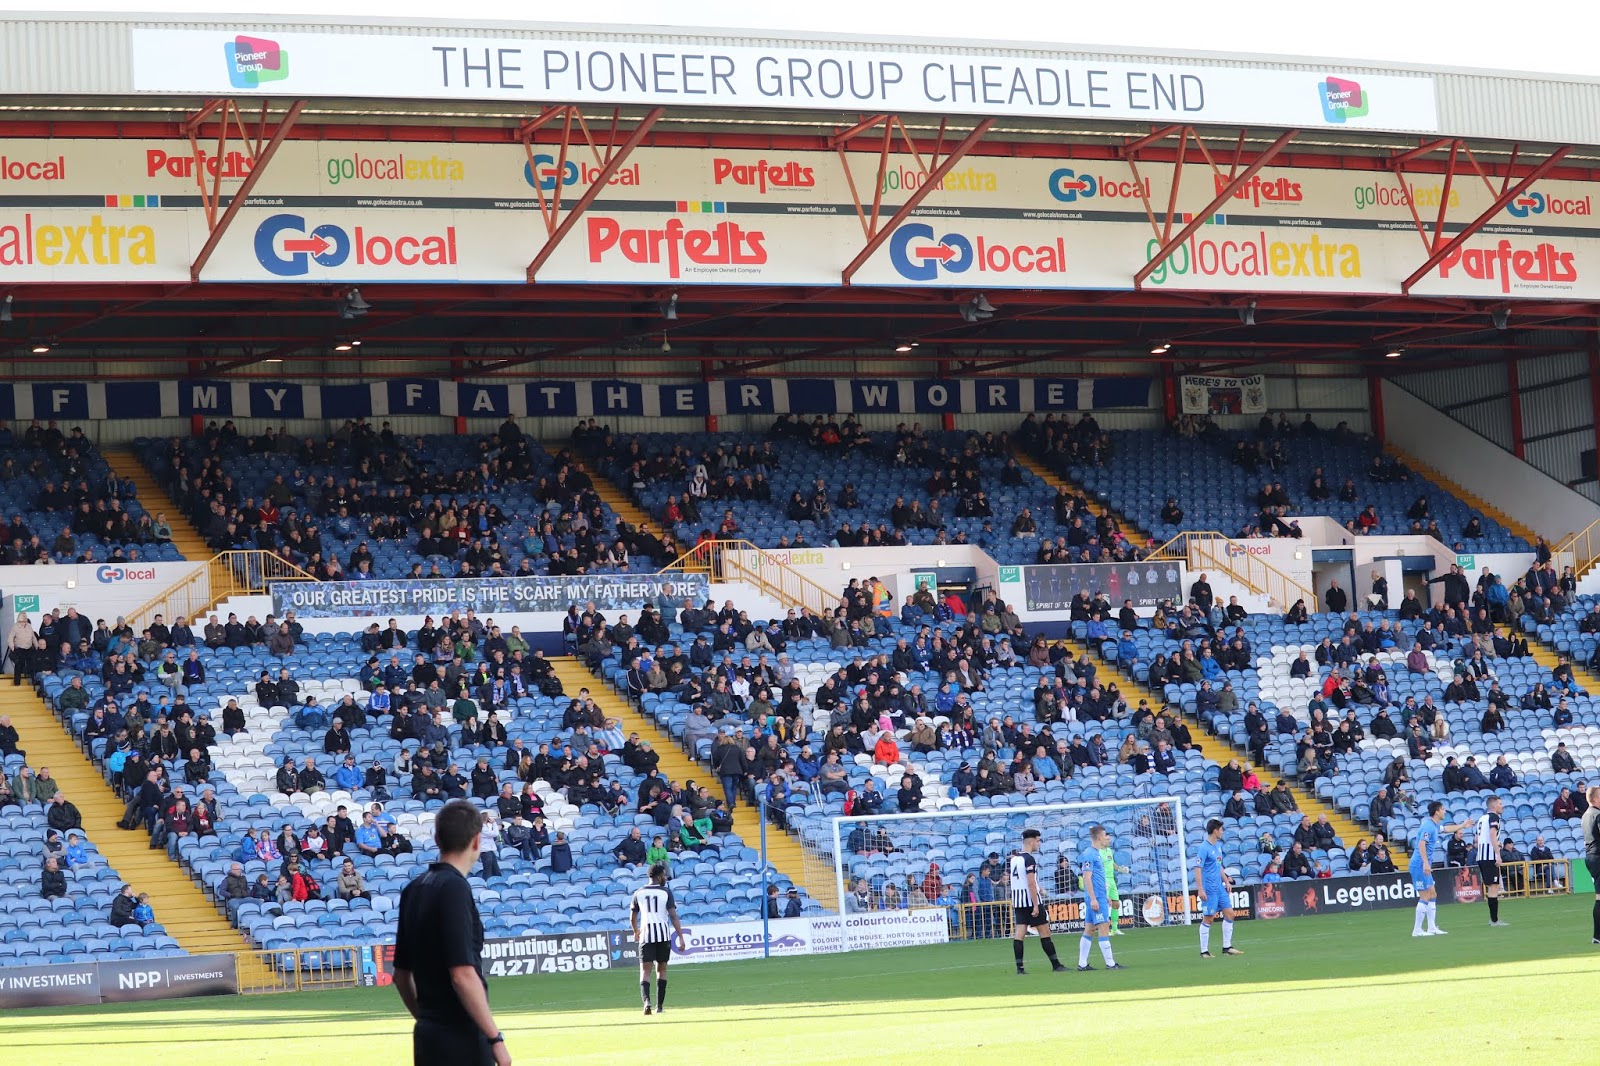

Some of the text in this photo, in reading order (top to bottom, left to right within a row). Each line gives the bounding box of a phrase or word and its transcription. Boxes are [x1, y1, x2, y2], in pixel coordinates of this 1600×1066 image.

[234, 51, 267, 63] Pioneer
[236, 63, 263, 73] Group
[432, 46, 1205, 113] THE PIONEER GROUP CHEADLE END
[1327, 91, 1352, 101] Pioneer
[1328, 101, 1348, 110] Group
[1, 156, 65, 180] local
[327, 153, 464, 184] golocalextra
[714, 158, 815, 194] Parfetts
[1048, 168, 1151, 202] Go local
[1355, 181, 1459, 209] golocalexta
[357, 198, 423, 207] www.golocalextra.co.uk
[787, 206, 837, 214] www.parfetts.co.uk
[1546, 194, 1591, 215] local
[254, 213, 457, 277] Go local
[587, 217, 767, 279] Parfetts
[889, 222, 1066, 281] Go local
[1146, 231, 1361, 285] golocalextra
[1437, 237, 1577, 293] Parfetts
[1185, 377, 1220, 387] HERE'S
[1241, 377, 1261, 386] YOU
[97, 565, 155, 583] Go local
[293, 591, 325, 606] OUR
[330, 588, 408, 606] GREATEST
[412, 587, 457, 603] PRIDE
[461, 587, 475, 602] IS
[480, 586, 509, 601] THE
[513, 585, 563, 600] SCARF
[567, 584, 589, 599] MY
[594, 583, 650, 599] FATHER
[1139, 598, 1156, 606] SPIRIT
[1012, 864, 1020, 880] 4
[1167, 891, 1250, 913] vanama
[1323, 879, 1420, 907] Legenda
[645, 895, 658, 913] 11
[1048, 899, 1134, 921] vanaa
[812, 913, 944, 929] wwwcolourtone.co.uk
[670, 928, 772, 955] Colourtone
[705, 944, 752, 952] LIMITED
[812, 935, 858, 944] COLOURTNE
[490, 953, 609, 977] 427 4588
[9, 972, 93, 989] INVESTMENT
[118, 971, 223, 990] NPP INVESTMENTS
